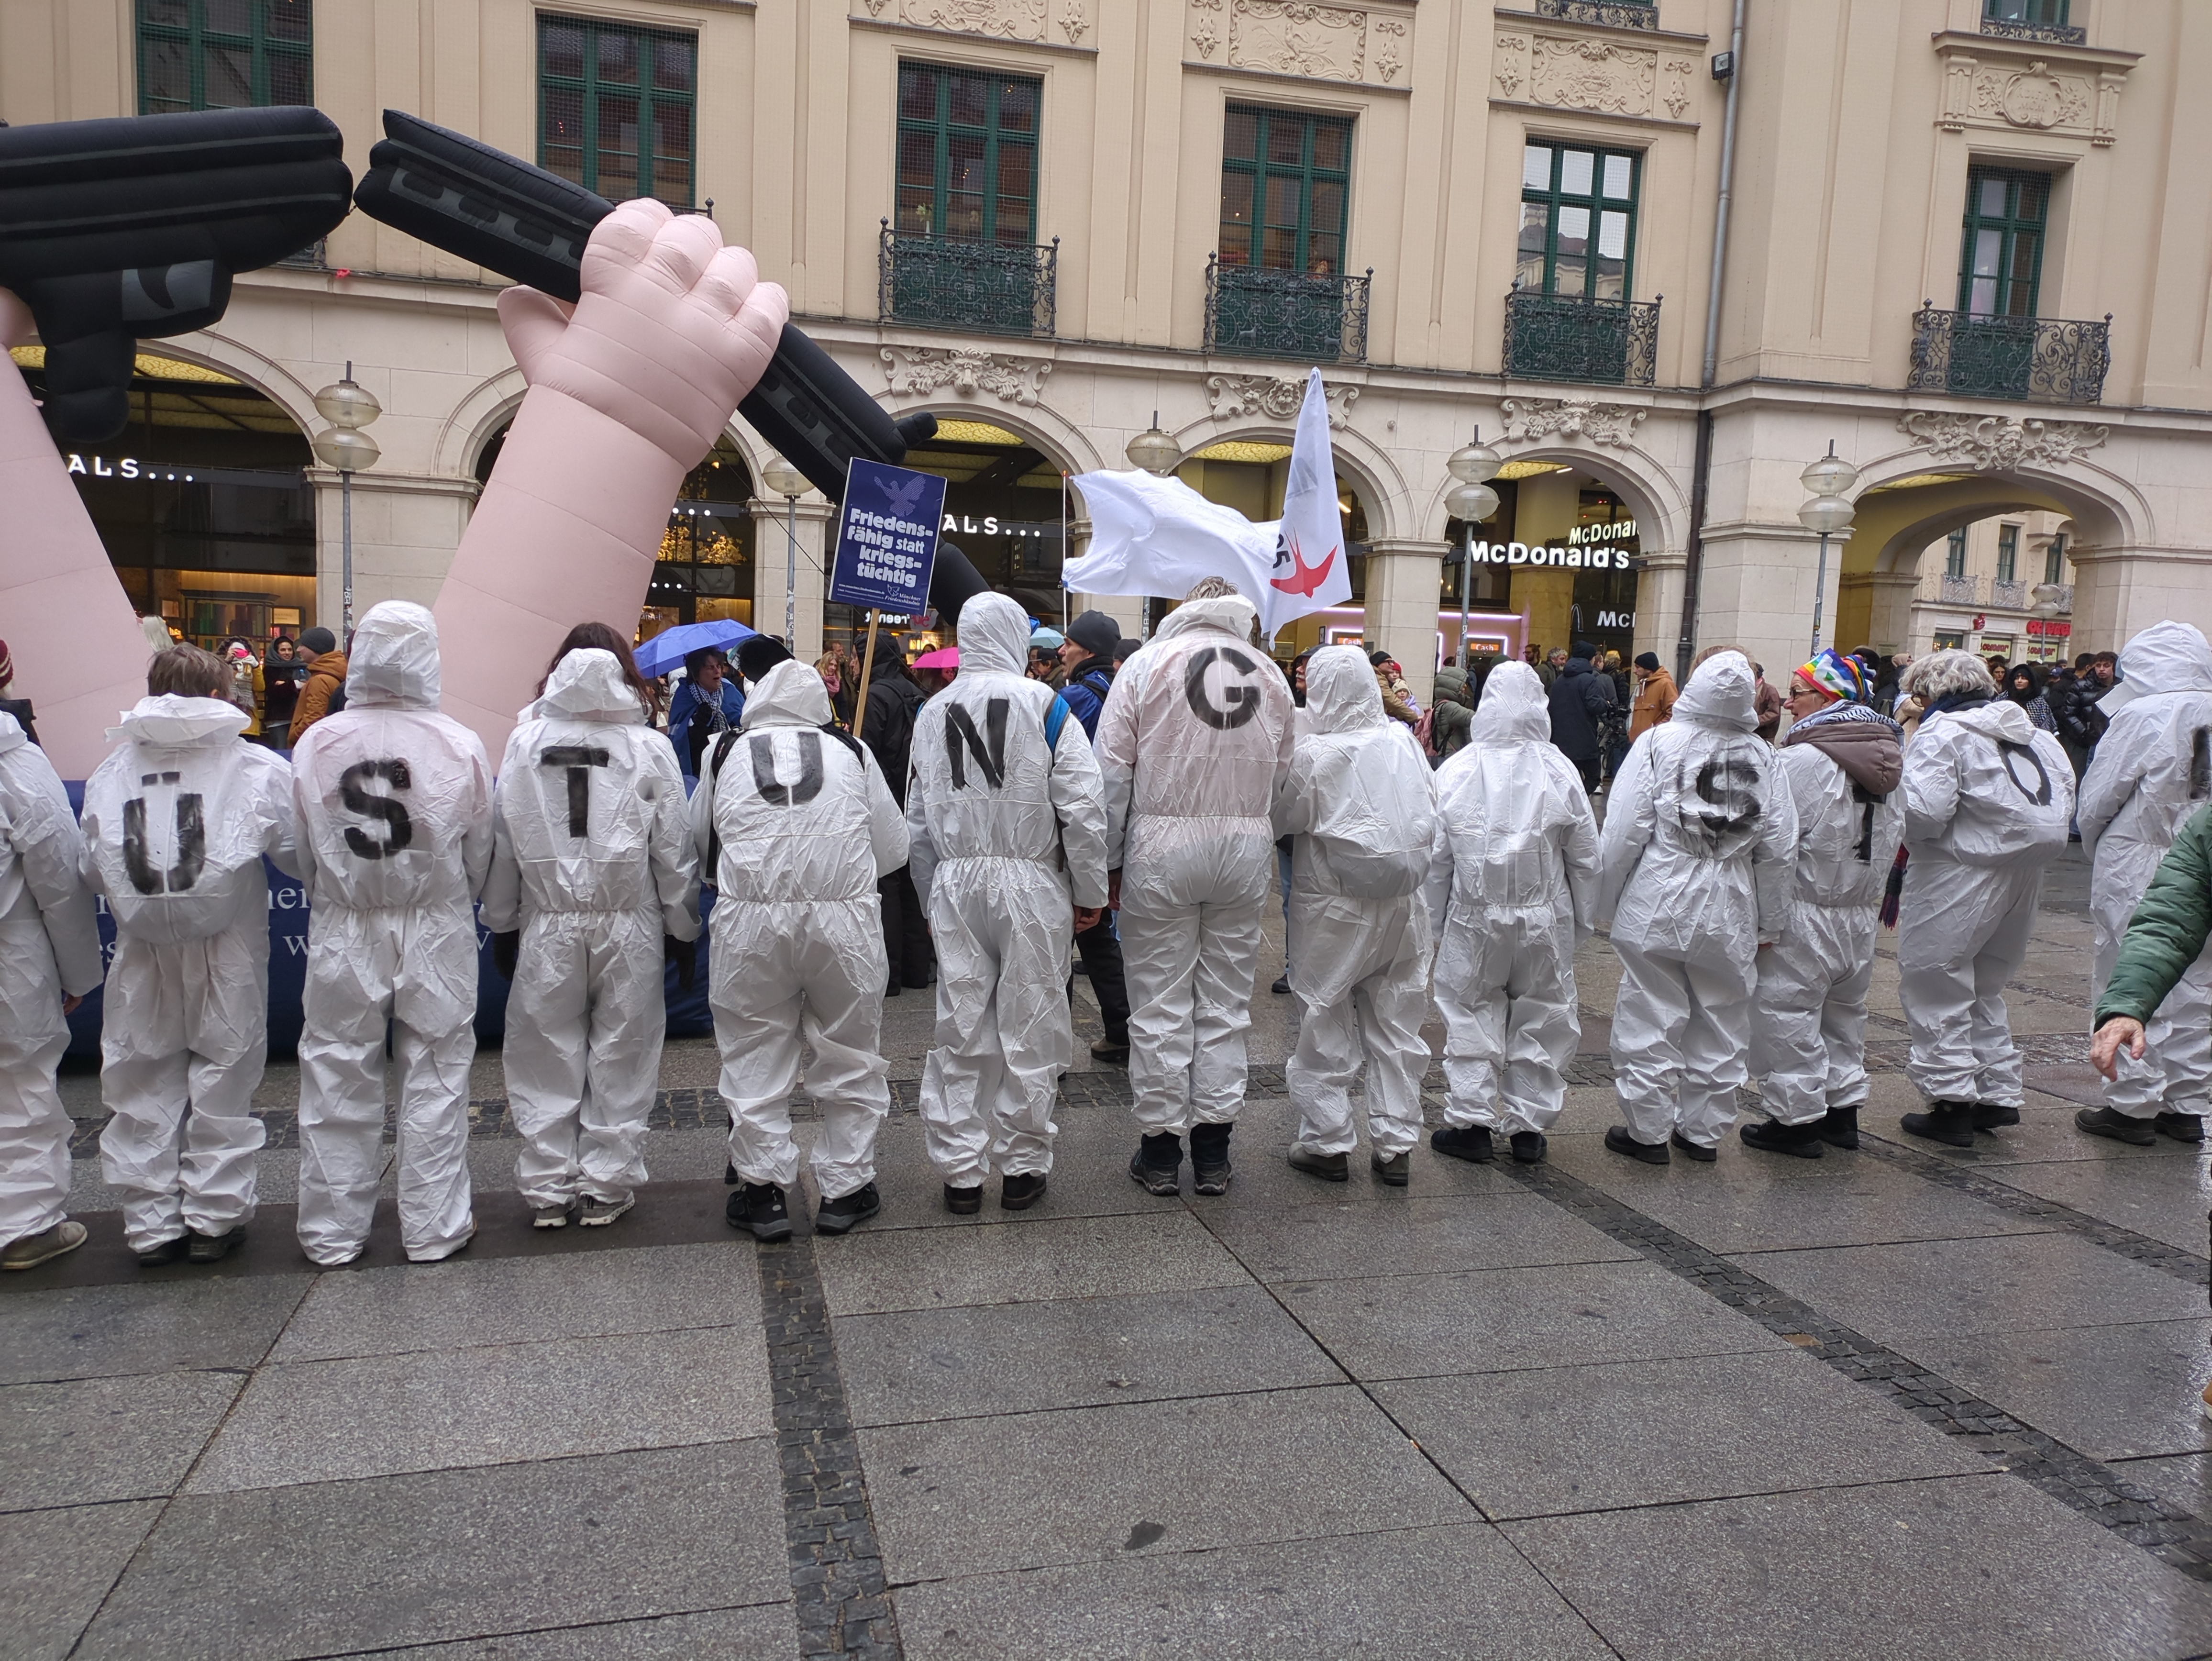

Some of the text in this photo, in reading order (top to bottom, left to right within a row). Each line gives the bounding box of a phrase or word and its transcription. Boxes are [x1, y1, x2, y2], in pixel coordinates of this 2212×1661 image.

[850, 508, 933, 537] Friedens-
[1569, 519, 1640, 545] McDonal
[847, 525, 925, 554] fähig statt
[859, 545, 922, 568] kriegs-
[1465, 541, 1629, 568] McDonald's
[857, 562, 917, 587] tüchtig
[885, 595, 920, 606] Friedensbündnis
[898, 593, 921, 601] Münchner
[1597, 610, 1636, 628] Mc
[1185, 647, 1261, 730] G
[945, 698, 1008, 790] N
[749, 731, 824, 807] U
[541, 746, 609, 838] T
[1695, 760, 1761, 833] S
[338, 757, 412, 860] S
[122, 771, 206, 895] Ü
